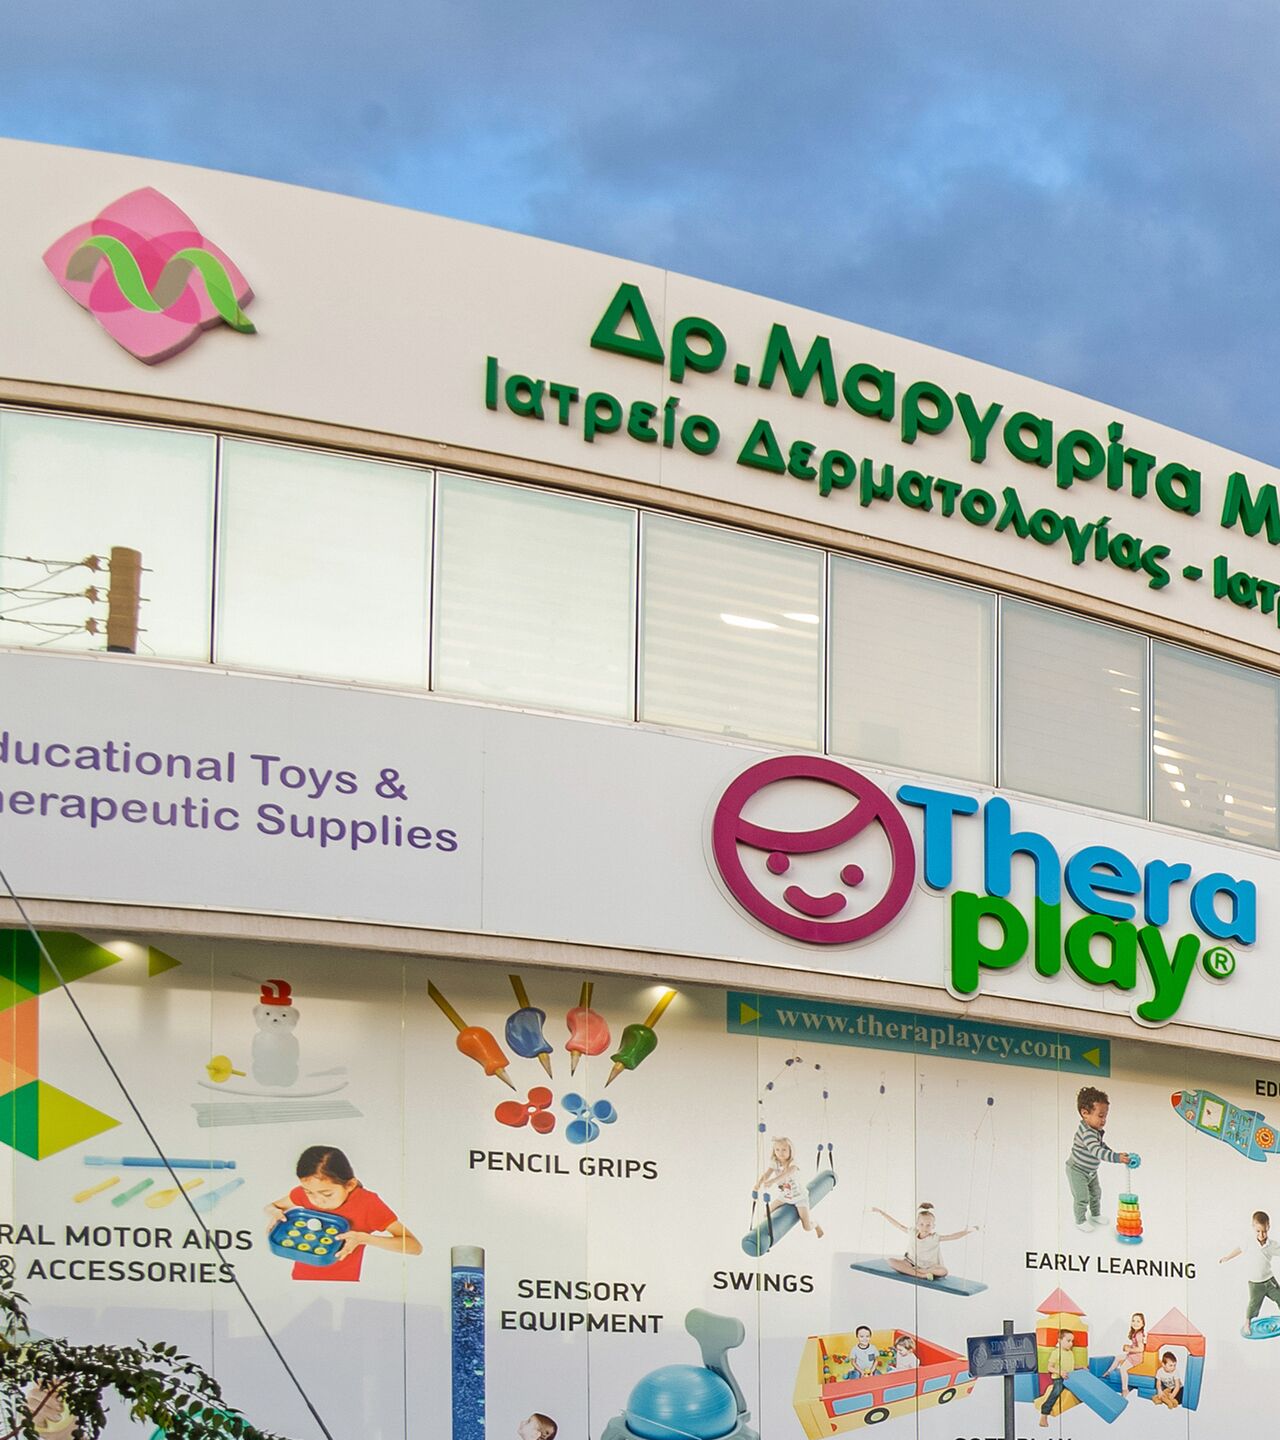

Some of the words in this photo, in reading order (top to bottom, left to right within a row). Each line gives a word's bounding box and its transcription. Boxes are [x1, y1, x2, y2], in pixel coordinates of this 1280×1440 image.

[486, 356, 722, 455] Ιατρείο
[737, 418, 1171, 590] Δερματολογίας
[250, 754, 358, 800] Toys
[375, 768, 409, 801] &
[0, 789, 240, 829] erapeutic
[256, 803, 459, 852] Supplies
[896, 784, 1257, 946] Thera
[951, 889, 1201, 1022] play
[776, 1007, 1072, 1062] www.theraplaycy.com
[469, 1150, 570, 1175] PENCIL
[579, 1157, 659, 1180] GRIPS
[66, 1225, 173, 1248] MOTOR
[182, 1229, 253, 1250] AIDS
[27, 1259, 236, 1283] ACCESSORIES
[1025, 1252, 1091, 1273] EARLY
[1097, 1256, 1196, 1280] LEARNING
[517, 1278, 647, 1302] SENSORY
[713, 1271, 814, 1294] SWINGS
[501, 1310, 664, 1334] EQUIPMENT
